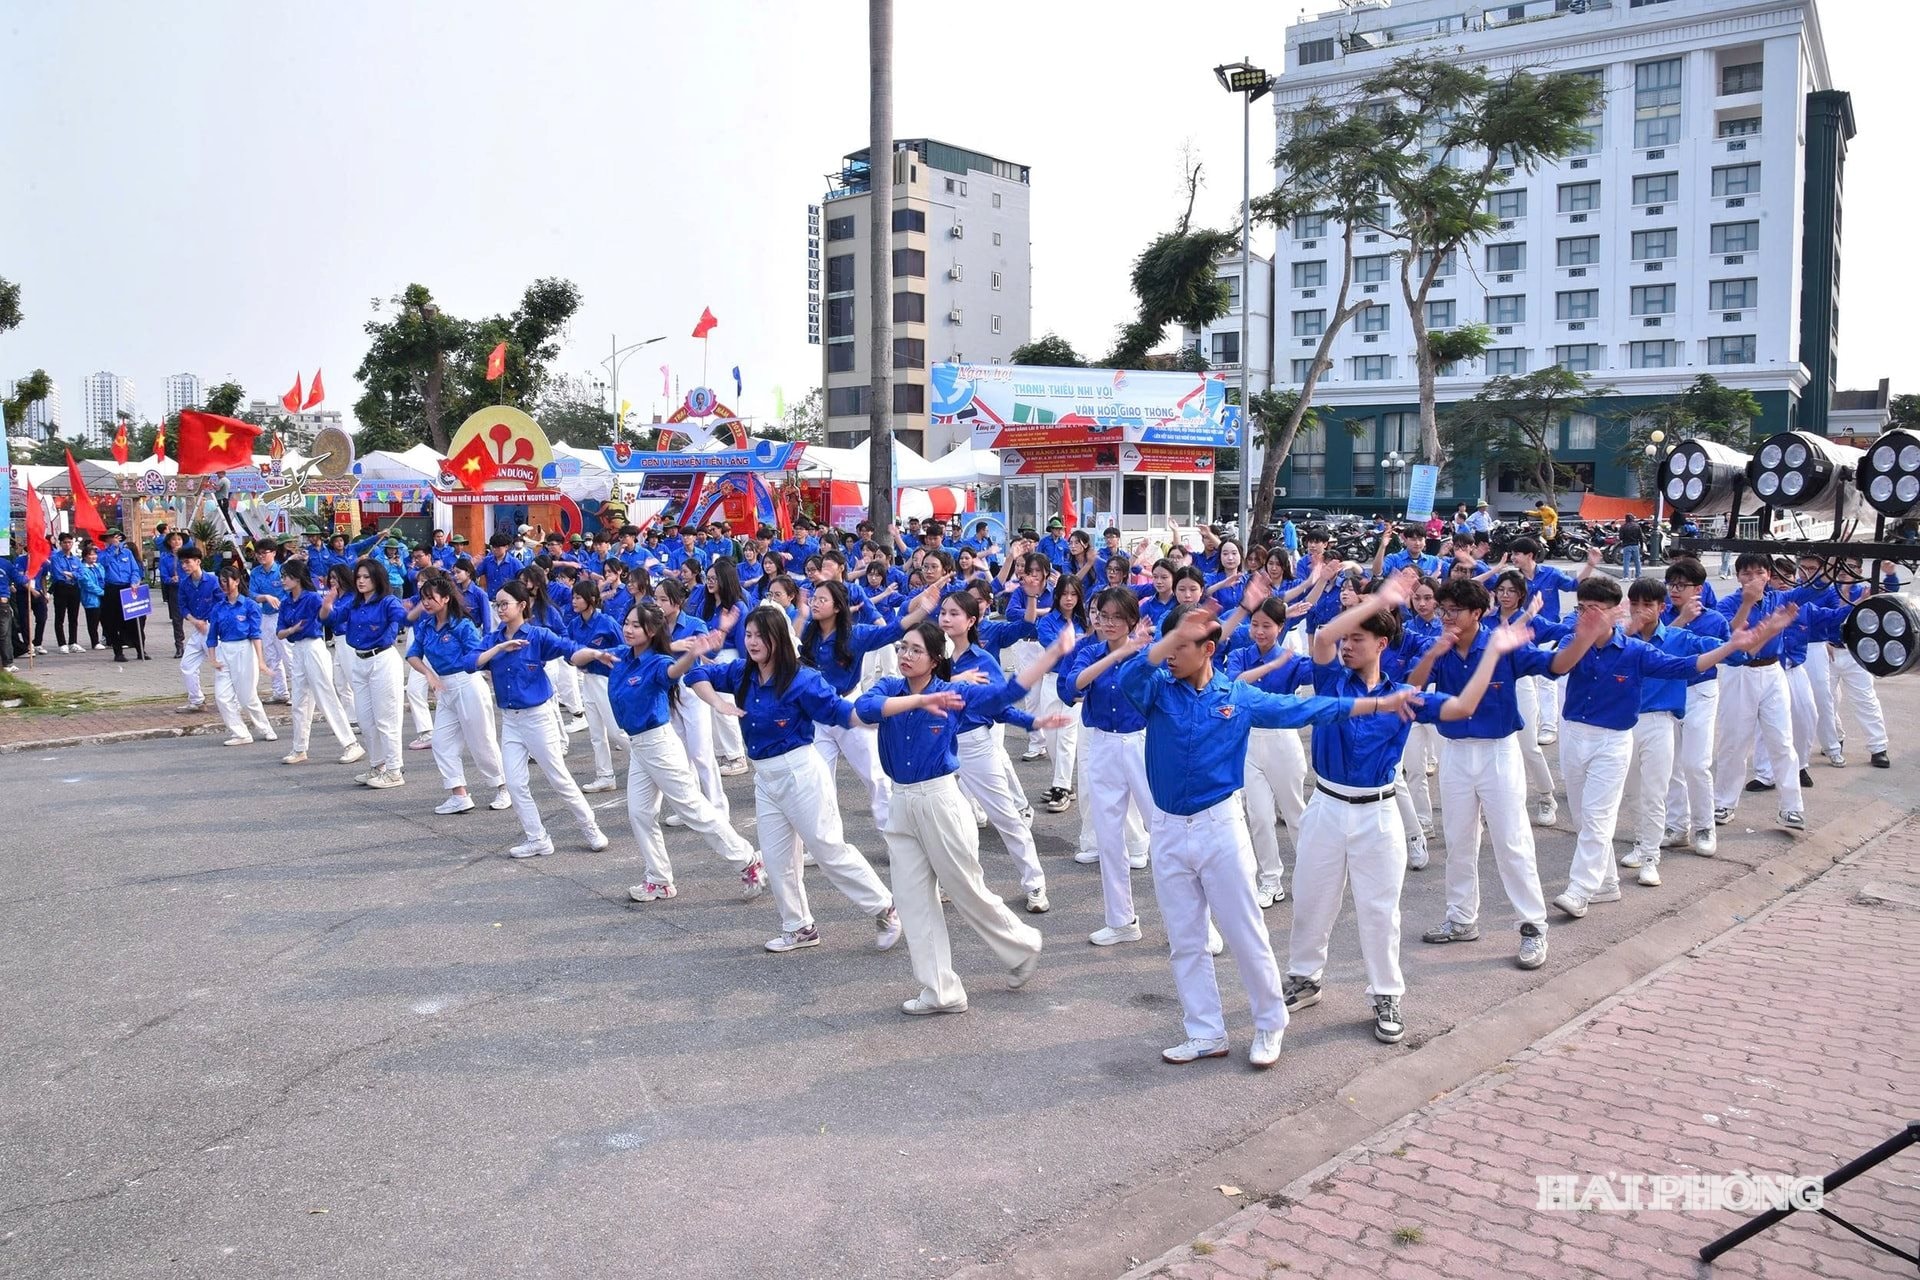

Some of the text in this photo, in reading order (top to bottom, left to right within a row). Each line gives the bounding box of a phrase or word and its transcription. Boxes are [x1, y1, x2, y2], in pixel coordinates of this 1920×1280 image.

[809, 205, 819, 344] THE TIMES HOTEL
[1014, 384, 1046, 396] THANH
[1077, 385, 1094, 397] NHI
[1119, 405, 1142, 417] GIAO
[508, 468, 534, 481] DƯƠNG
